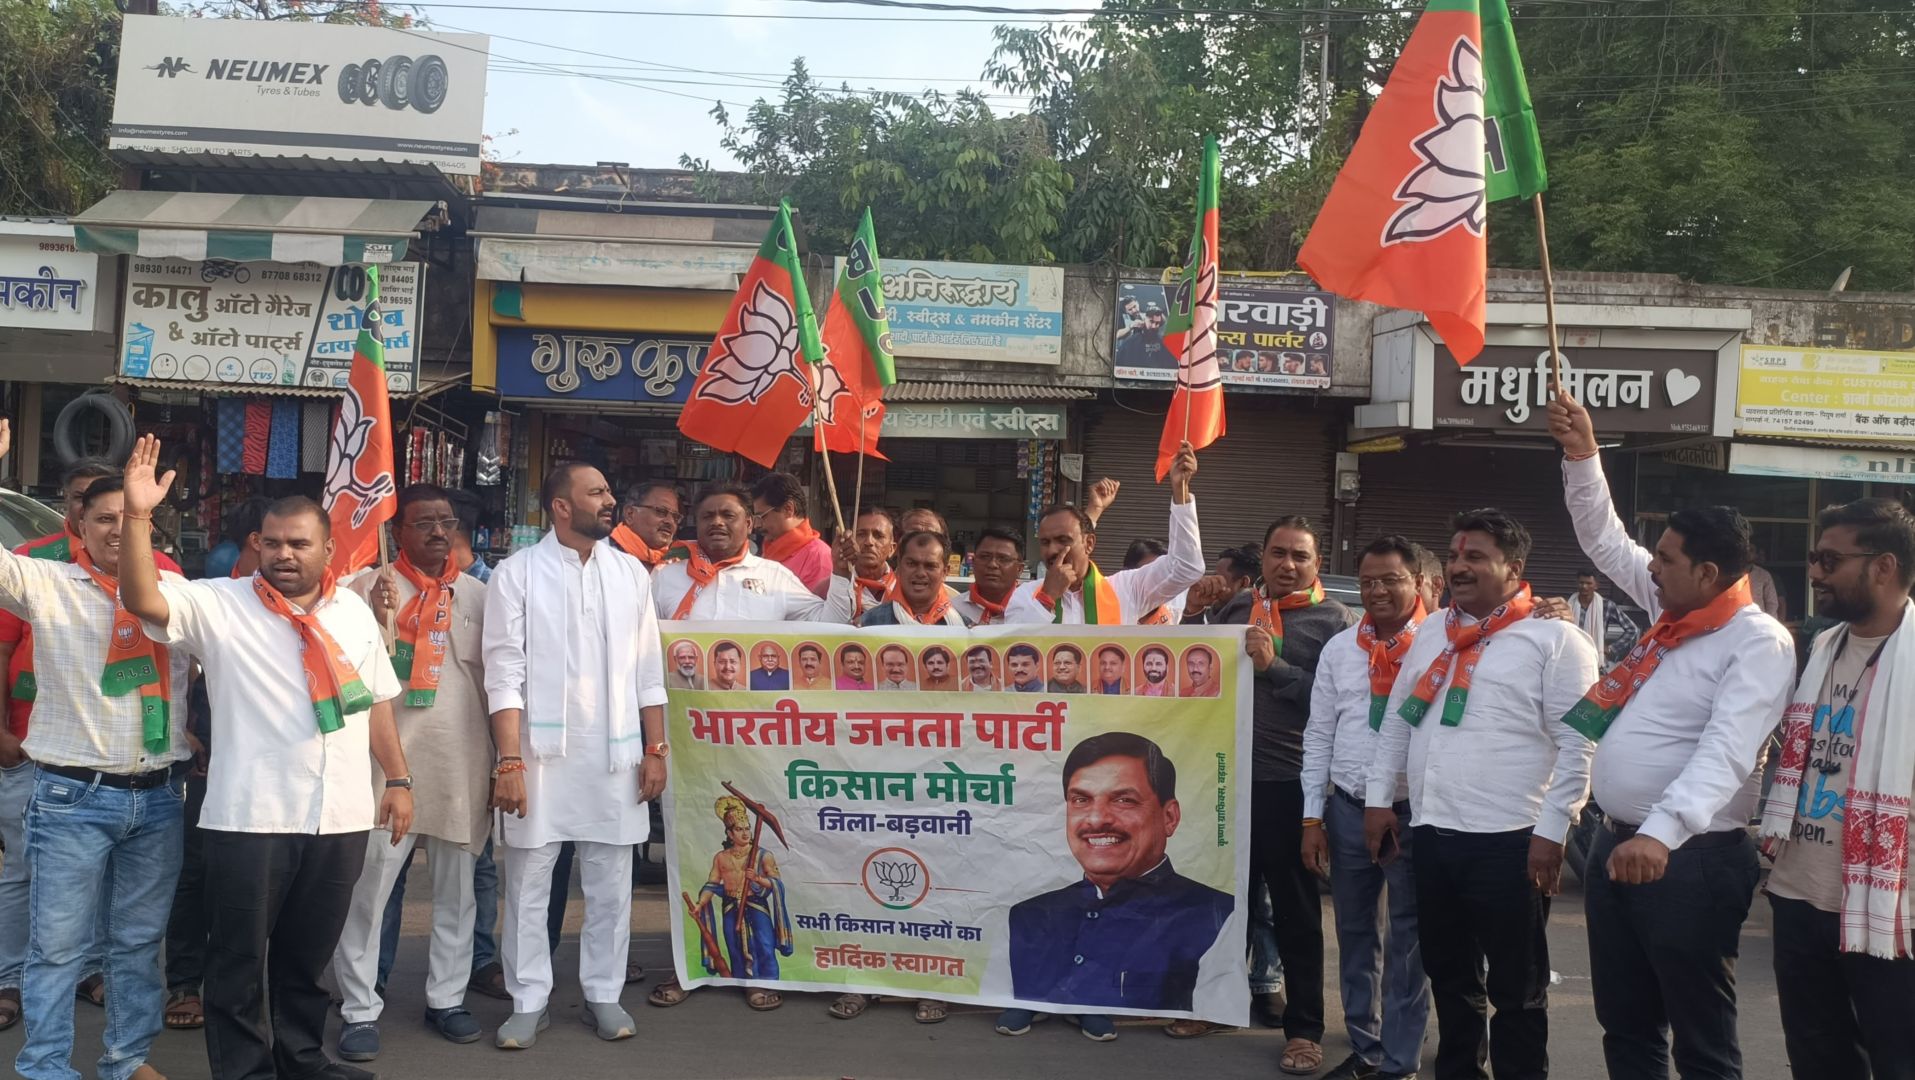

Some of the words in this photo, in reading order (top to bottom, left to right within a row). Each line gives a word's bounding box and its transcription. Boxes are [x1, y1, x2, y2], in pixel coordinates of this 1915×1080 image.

[205, 58, 329, 85] NEUMEX
[257, 85, 281, 97] Tyres
[284, 86, 291, 96] &
[292, 87, 321, 98] Tubes
[134, 263, 162, 274] 98930
[166, 265, 192, 275] 14471
[261, 270, 290, 281] 87708
[293, 272, 322, 282] 68312
[214, 293, 261, 315] ऑटो
[265, 294, 312, 318] गैरेज
[954, 314, 966, 326] &
[970, 312, 1019, 328] नमकीन
[168, 321, 184, 342] &
[191, 328, 240, 348] ऑटो
[1253, 331, 1306, 348] पार्लर
[252, 371, 273, 380] TVS
[1842, 378, 1908, 390] CUSTOMER
[1780, 389, 1829, 404] Center
[958, 408, 987, 431] एवं
[688, 698, 838, 747] भारतीय
[846, 711, 964, 748] जनता
[972, 701, 1068, 752] पार्टी
[784, 759, 917, 801] किसान
[924, 761, 1017, 805] मोर्चा
[796, 912, 830, 931] सभी
[834, 913, 895, 935] किसान
[899, 919, 952, 941] भाइयों
[956, 924, 982, 942] का
[814, 944, 887, 970] हार्दिक
[890, 952, 966, 977] स्वागत
